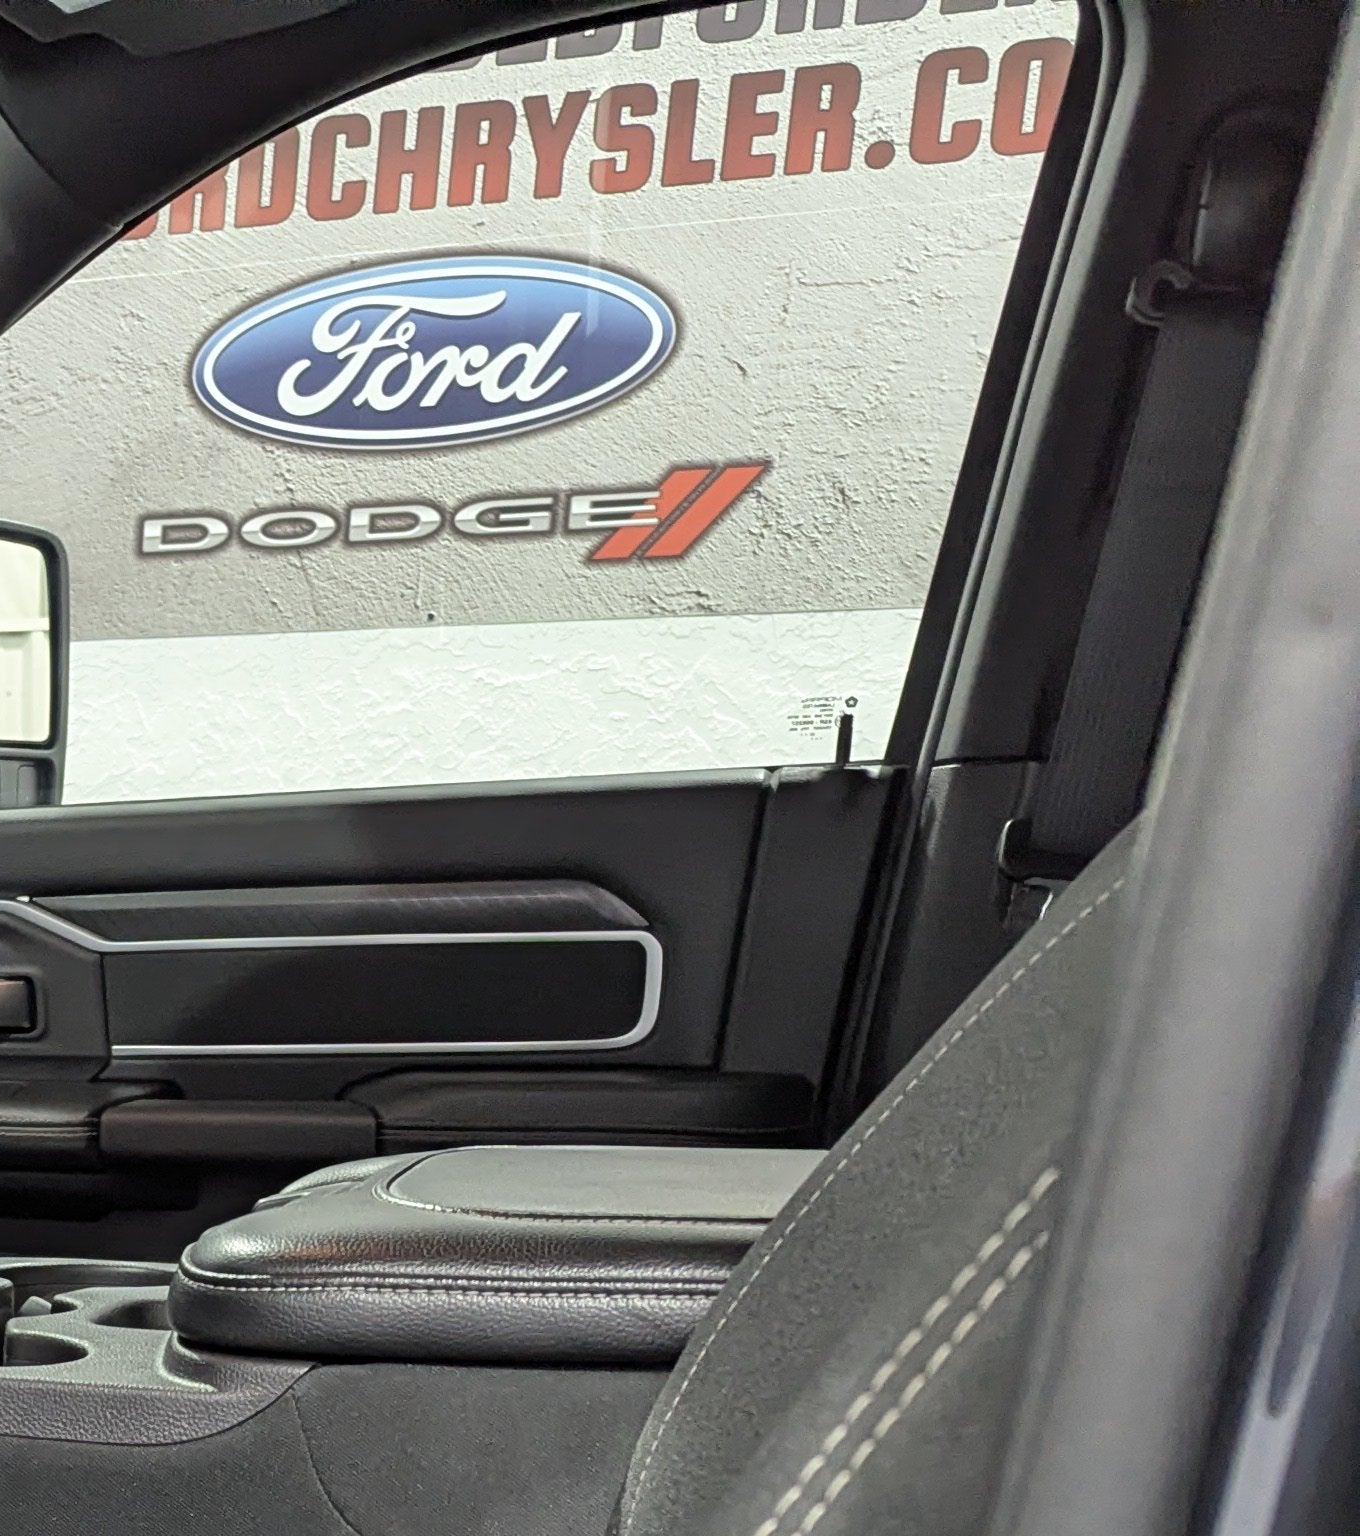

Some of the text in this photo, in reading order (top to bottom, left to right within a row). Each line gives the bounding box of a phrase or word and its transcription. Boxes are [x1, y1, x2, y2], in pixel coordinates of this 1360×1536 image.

[120, 37, 1076, 241] DCHRYSLER.CO
[277, 289, 584, 417] Ford
[140, 489, 661, 554] DODGE
